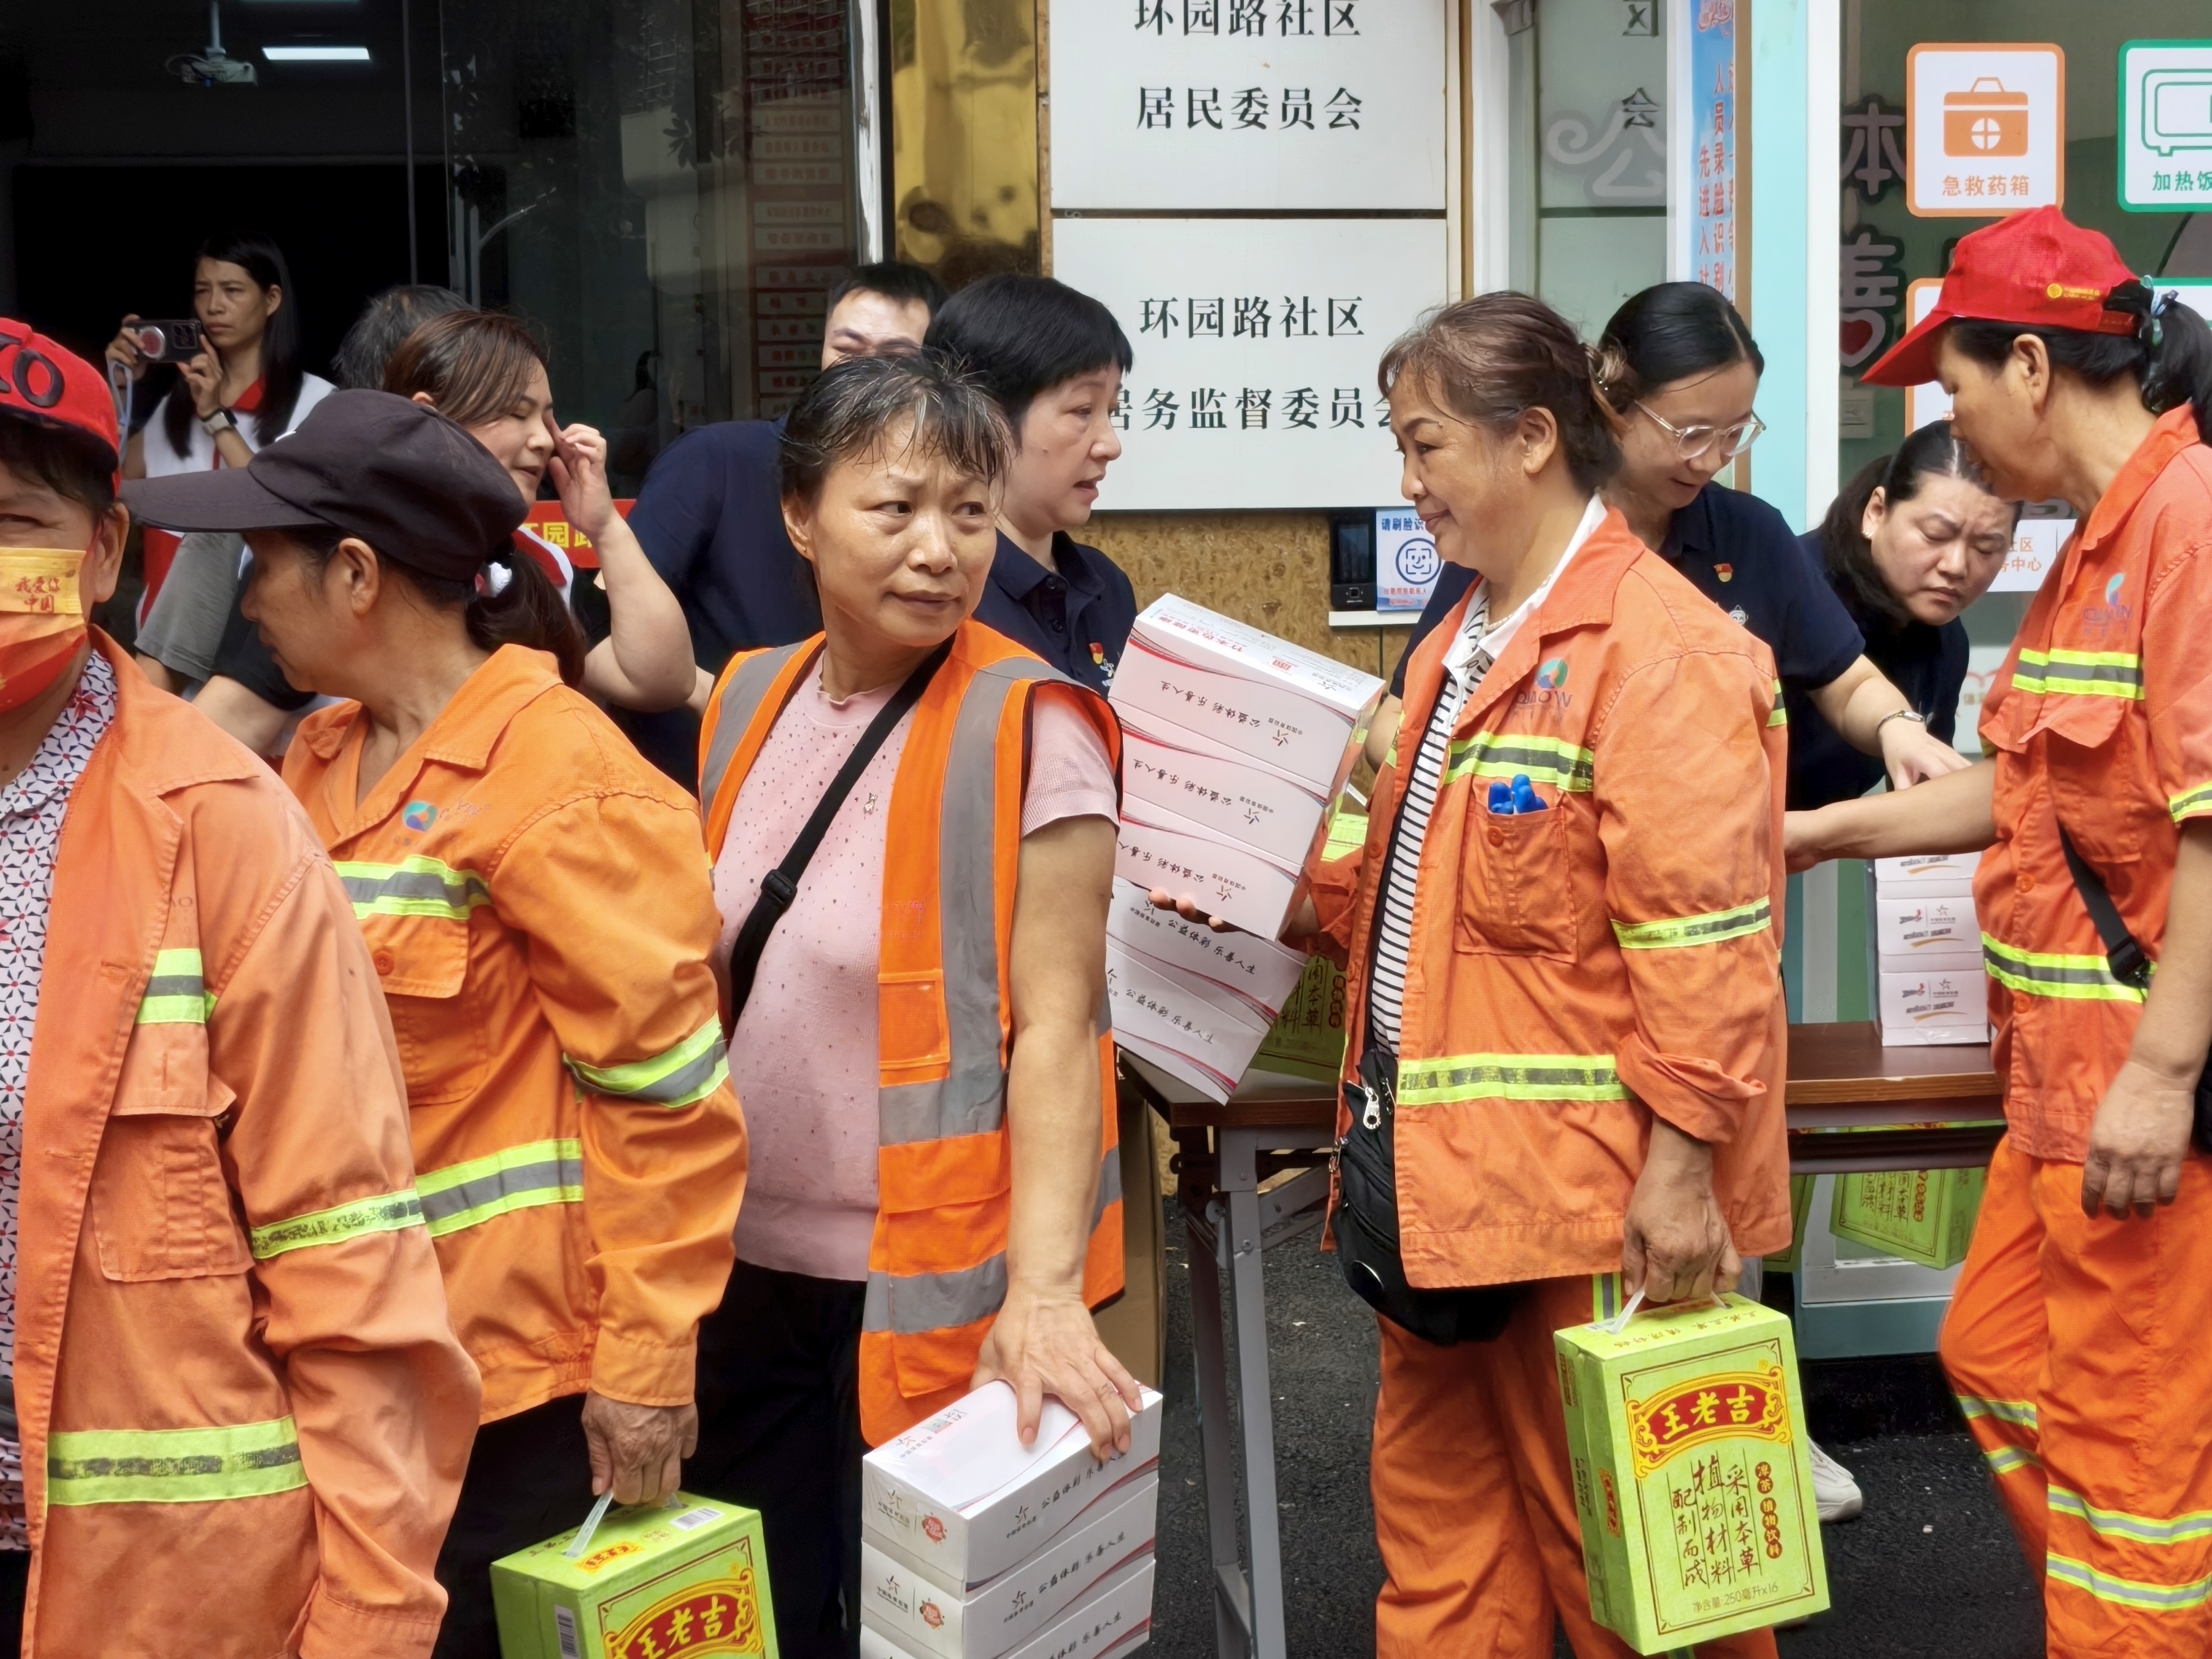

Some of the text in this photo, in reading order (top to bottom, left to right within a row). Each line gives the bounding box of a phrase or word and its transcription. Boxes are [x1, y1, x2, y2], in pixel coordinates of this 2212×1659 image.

[1135, 0, 1361, 37] 环园路社区
[1137, 86, 1363, 130] 居民委员会
[1942, 174, 2029, 197] 急救药箱
[1139, 295, 1365, 339] 环园路社区
[1161, 680, 1260, 728] 公益体彩 乐善人生
[1133, 759, 1232, 806] 公益体彩 乐善人生
[1157, 858, 1204, 883] 公益体彩
[1168, 919, 1257, 975] 公益体彩 乐善人生
[1126, 988, 1214, 1045] 公益体彩 乐善人生
[1660, 1385, 1755, 1441] 王老吉
[1671, 1487, 1707, 1587] 配制而成
[1692, 1454, 1734, 1586] 植物材料
[1726, 1464, 1759, 1578] 采用本草
[637, 1595, 727, 1659] 王老吉
